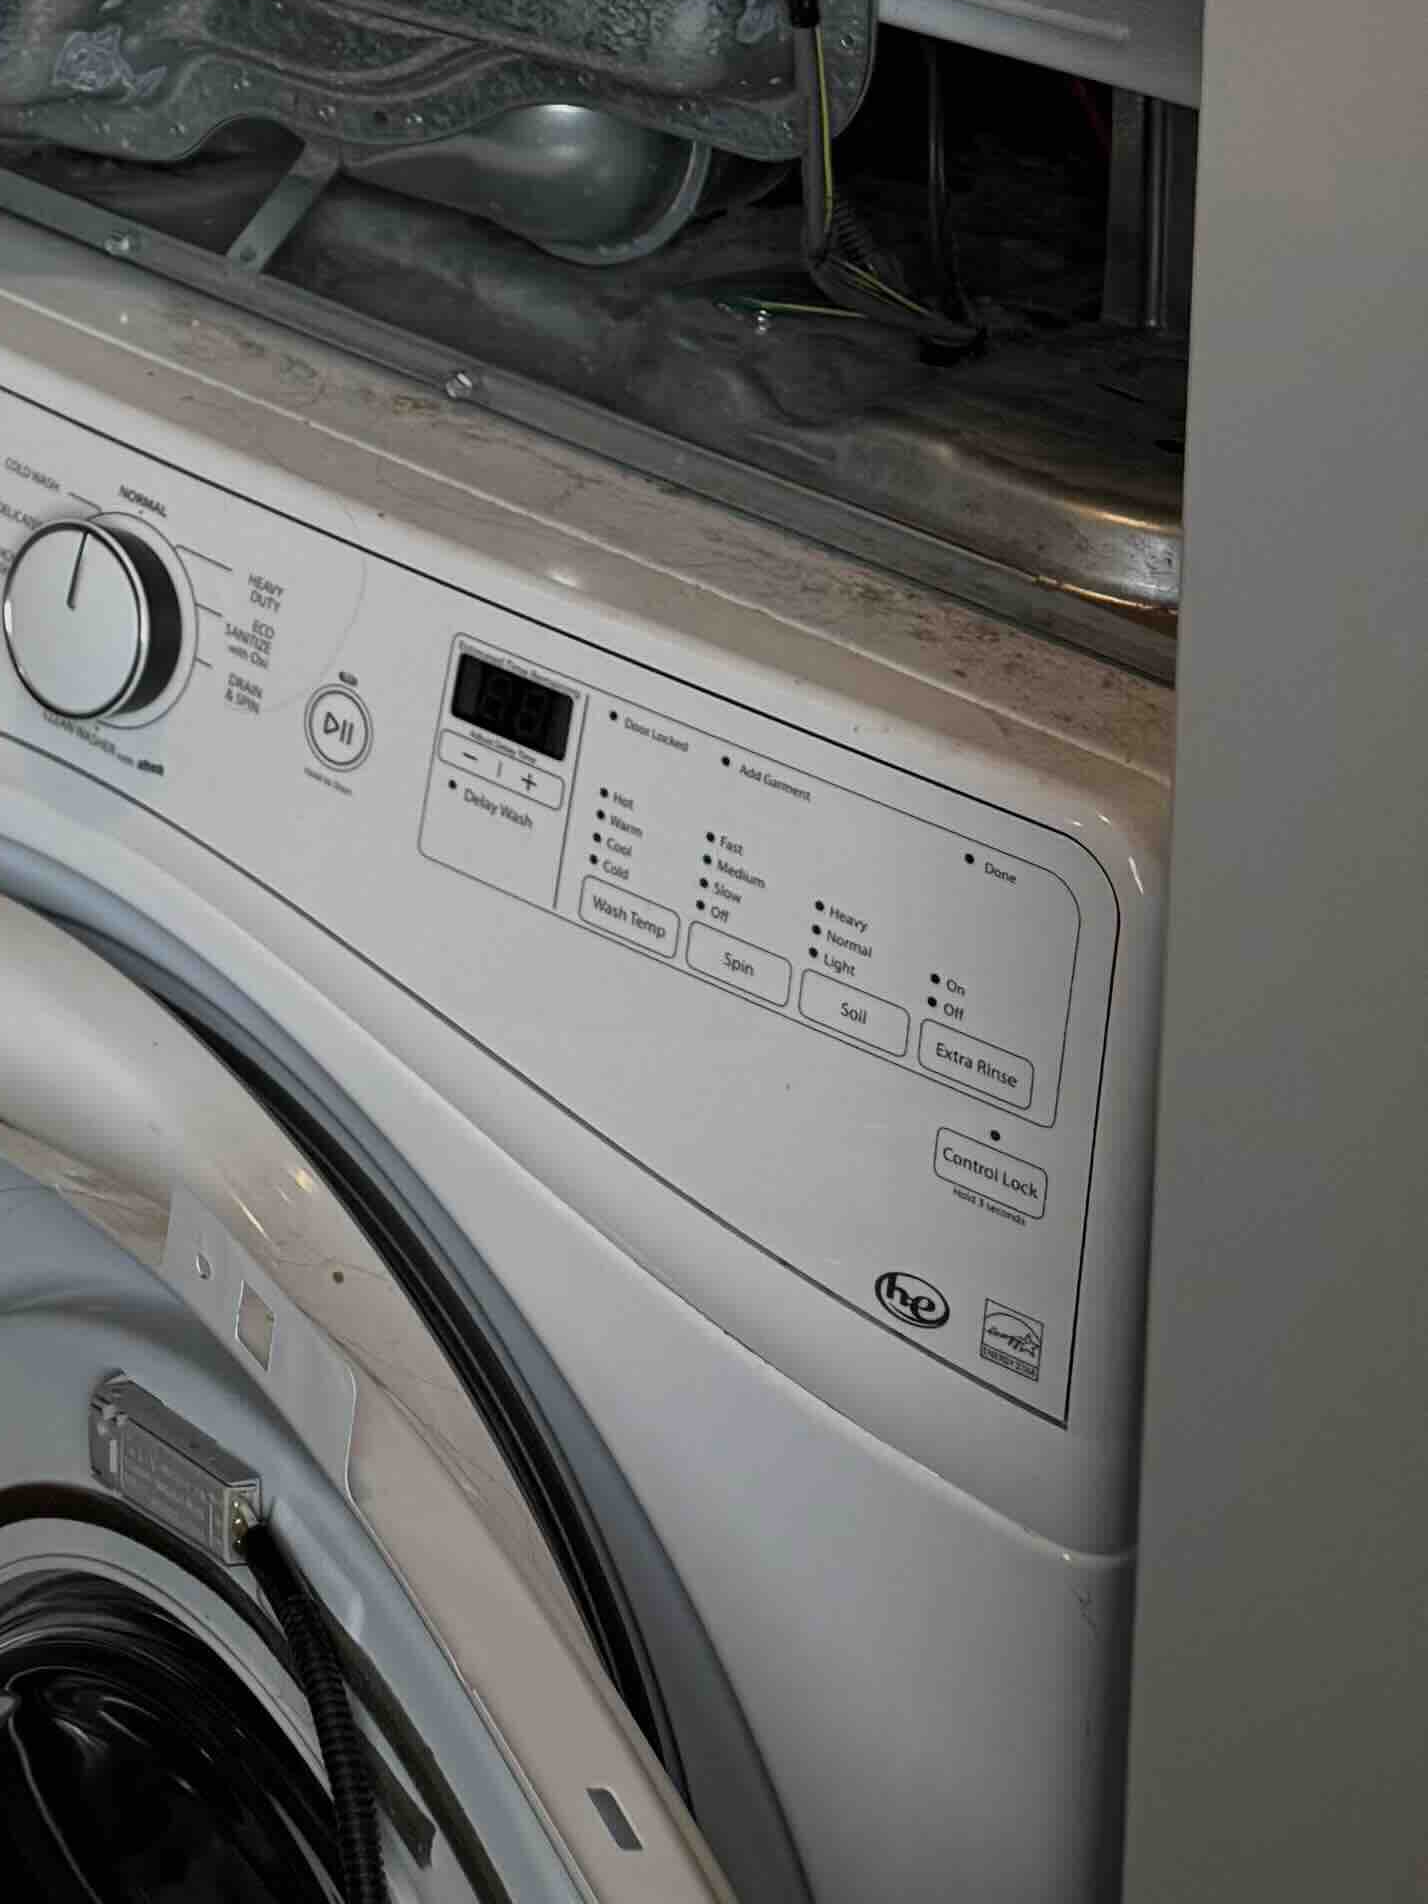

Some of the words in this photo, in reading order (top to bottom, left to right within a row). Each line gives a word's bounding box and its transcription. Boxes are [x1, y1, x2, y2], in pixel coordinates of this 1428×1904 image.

[5, 456, 30, 479] COLD
[118, 484, 167, 518] NORMAL
[248, 573, 284, 596] HEAVY
[250, 590, 281, 613] DUTY
[252, 619, 275, 639] ECO
[228, 672, 263, 699] DRAIN
[624, 717, 650, 737] Door
[652, 729, 689, 752] Locked
[739, 764, 761, 783] Add
[763, 774, 811, 803] Garment
[464, 788, 498, 816] Delay
[500, 804, 533, 830] Wash
[613, 792, 634, 810] Hot
[610, 816, 643, 837] Warm
[607, 837, 632, 857] Cool
[720, 835, 743, 856] Fast
[603, 860, 629, 881] Cold
[717, 859, 766, 888] Medium
[985, 862, 1017, 884] Done
[714, 882, 742, 903] Slow
[593, 895, 627, 922] Wash
[631, 911, 666, 939] Temp
[711, 906, 729, 923] Off
[830, 906, 868, 933] Heavy
[826, 930, 872, 958] Normal
[723, 952, 754, 977] Spin
[824, 954, 856, 977] Light
[946, 978, 965, 996] On
[841, 1002, 868, 1025] Soil
[943, 1003, 965, 1021] Off
[936, 1042, 973, 1070] Extra
[977, 1059, 1018, 1089] Rinse
[943, 1146, 999, 1183] Control
[1002, 1171, 1039, 1200] Lock
[953, 1188, 976, 1206] Hold
[987, 1201, 1026, 1227] seconds
[885, 1274, 937, 1320] he
